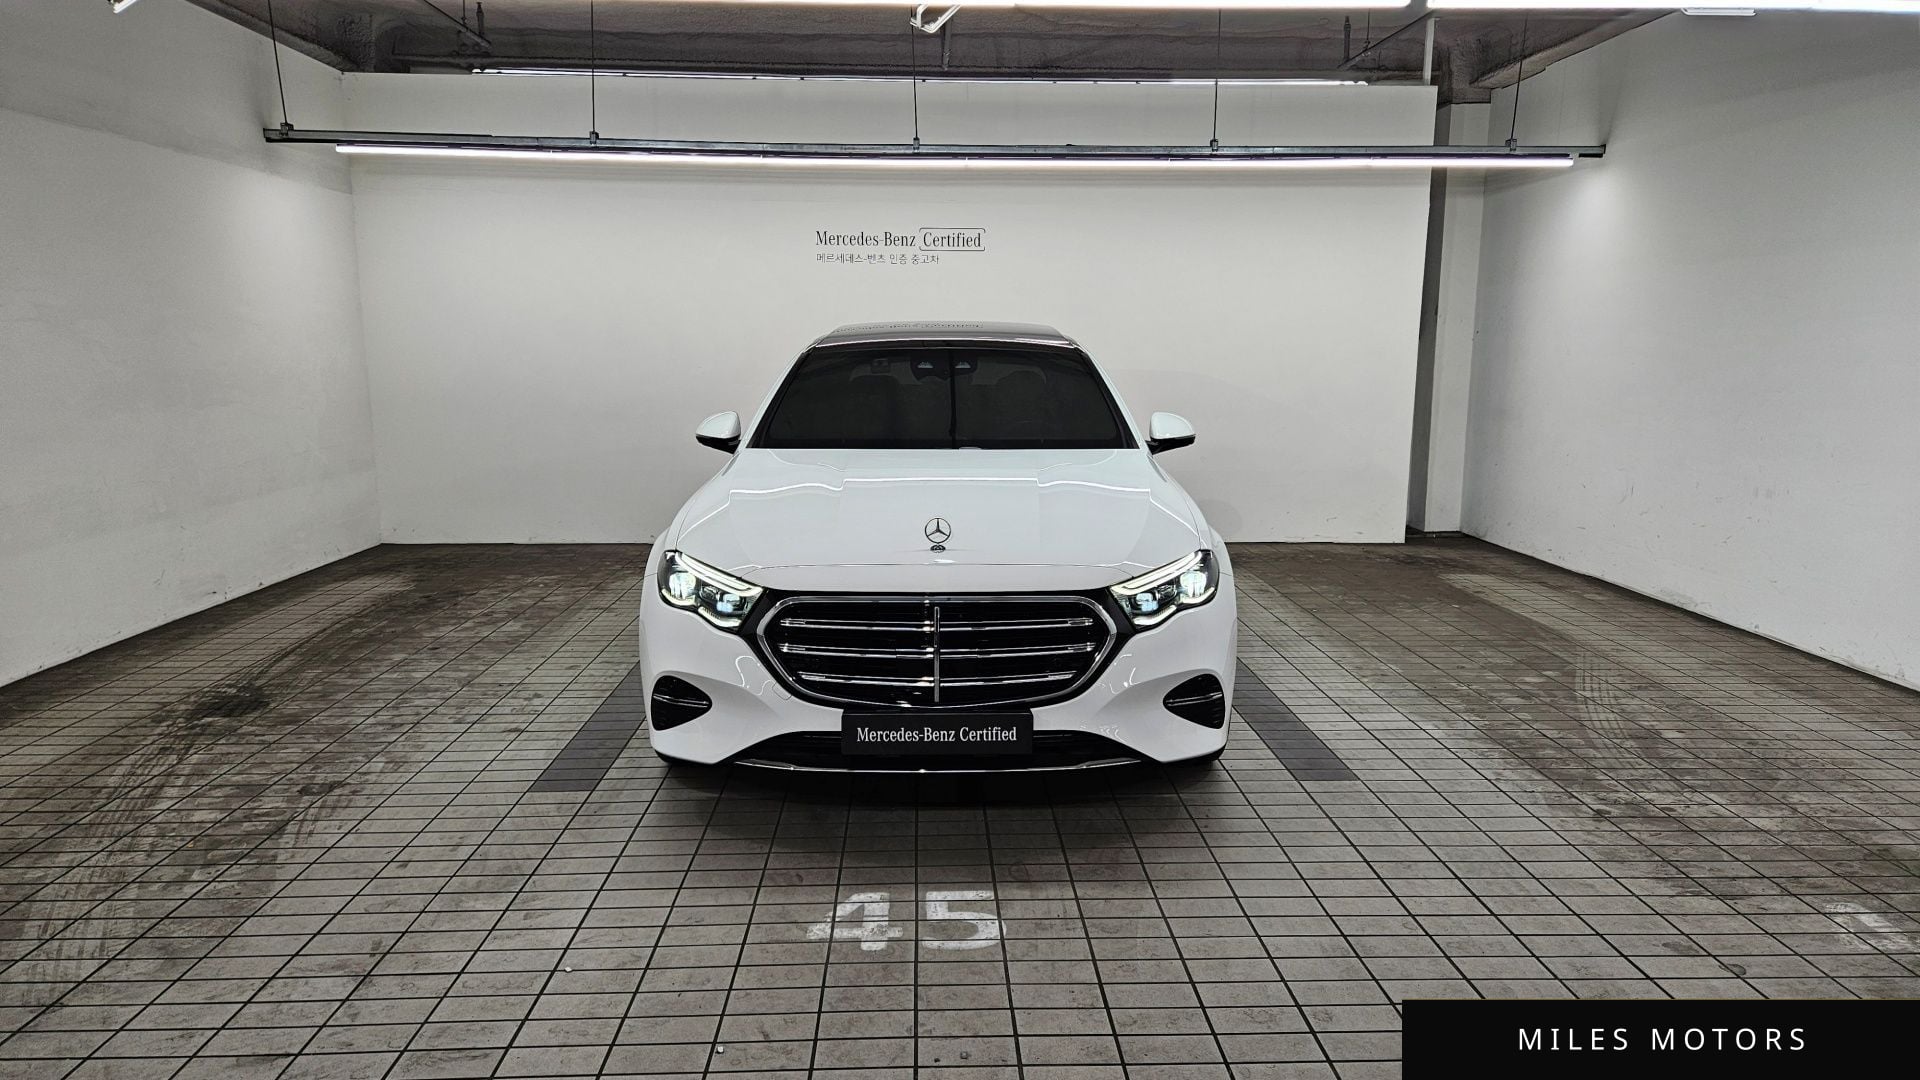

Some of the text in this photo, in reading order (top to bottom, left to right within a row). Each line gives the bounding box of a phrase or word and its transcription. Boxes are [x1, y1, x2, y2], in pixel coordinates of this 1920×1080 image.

[815, 230, 982, 248] Mercedes-Benz Certified
[816, 253, 940, 265] 메르세데스-벤츠 인증 중고차
[856, 726, 1018, 742] Mercedes-Benz Certified
[806, 890, 1007, 951] 45
